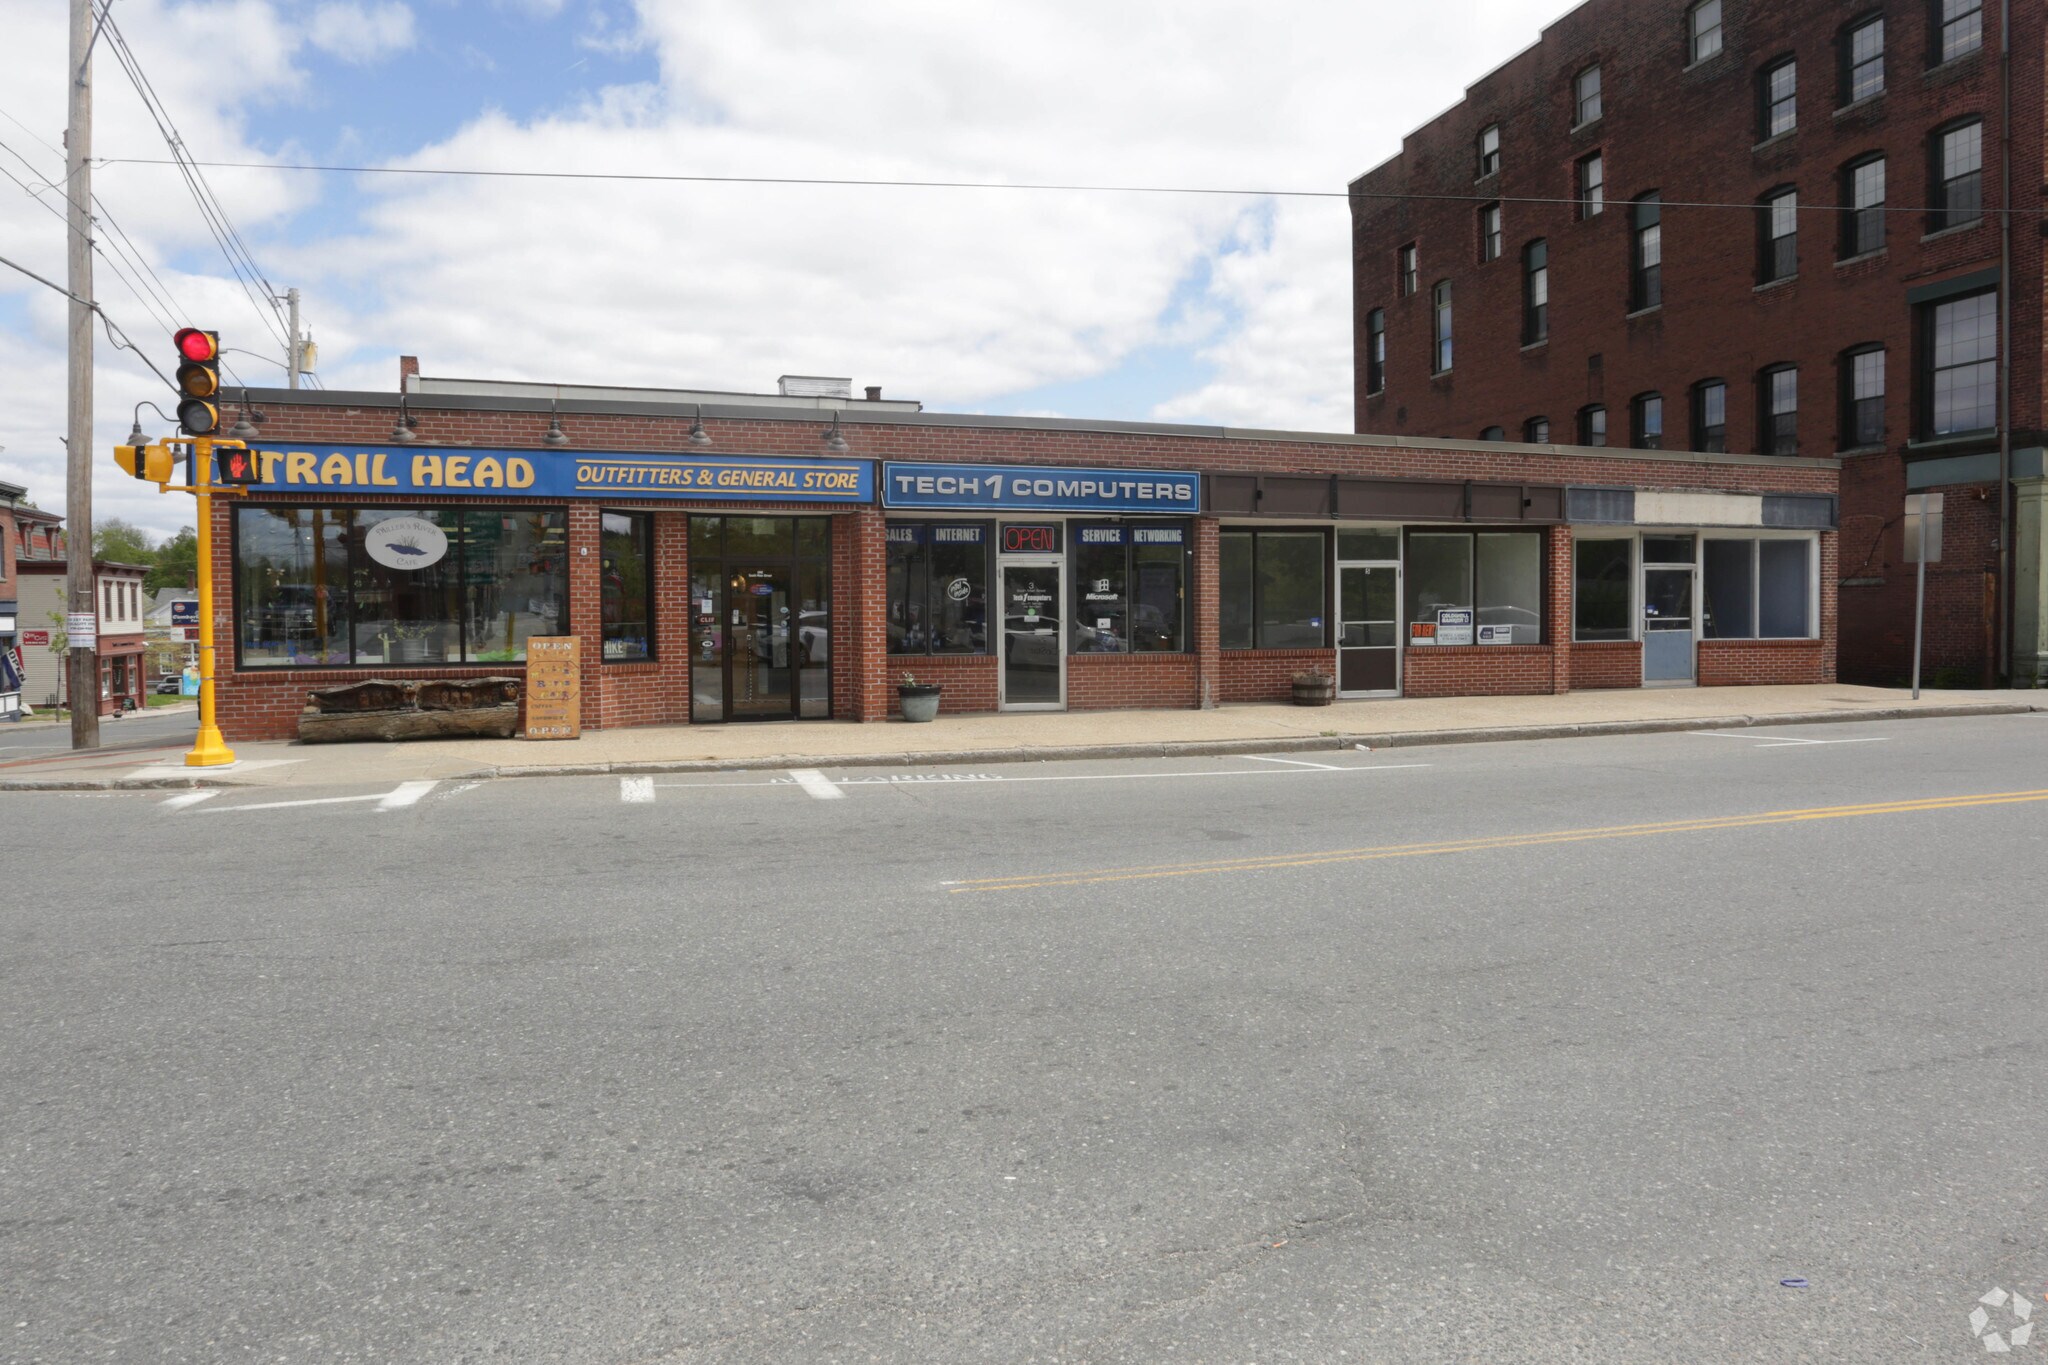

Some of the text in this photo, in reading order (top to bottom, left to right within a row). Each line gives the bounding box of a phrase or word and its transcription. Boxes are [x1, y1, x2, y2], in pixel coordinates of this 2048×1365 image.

[261, 451, 398, 486] TRAIL
[411, 455, 535, 488] HEAD
[576, 465, 859, 489] OUTFITTERS & GENERAL STORE
[895, 474, 1192, 500] TECH 1 COMPUTERS
[413, 522, 437, 536] RIVER
[885, 528, 913, 542] SALES
[935, 528, 980, 542] INTERNET
[1082, 529, 1121, 543] SERVICE
[1133, 529, 1183, 543] NETWORKING
[1006, 527, 1053, 550] OPEN
[1028, 581, 1035, 590] 3
[1085, 593, 1119, 601] Microsoft
[532, 642, 572, 650] OPEN
[529, 727, 572, 735] OPEN
